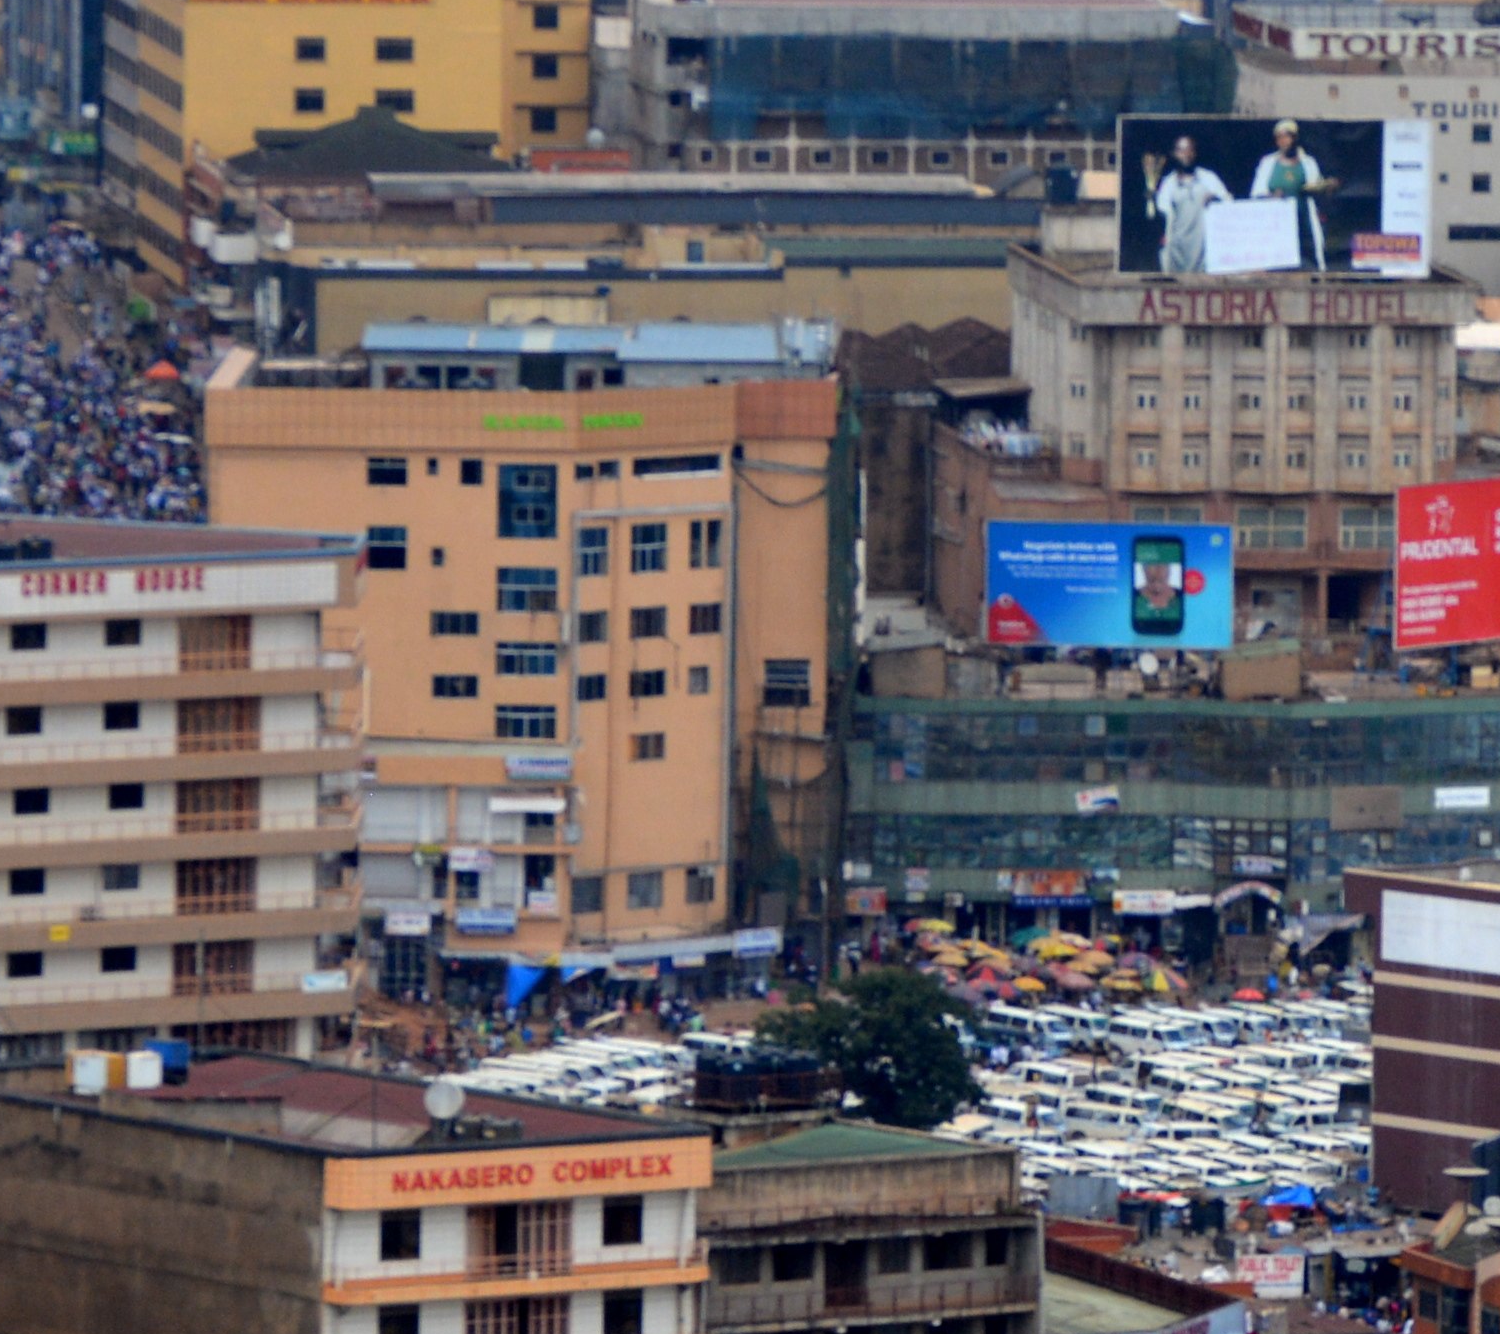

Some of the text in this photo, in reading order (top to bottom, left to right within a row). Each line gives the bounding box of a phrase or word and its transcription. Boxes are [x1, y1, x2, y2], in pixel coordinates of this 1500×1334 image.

[1139, 289, 1419, 324] ASTORIA HOTEL
[21, 571, 108, 598] CORNER
[135, 567, 206, 593] HOUSE
[392, 1154, 673, 1192] NAKASERO COMPLEX
